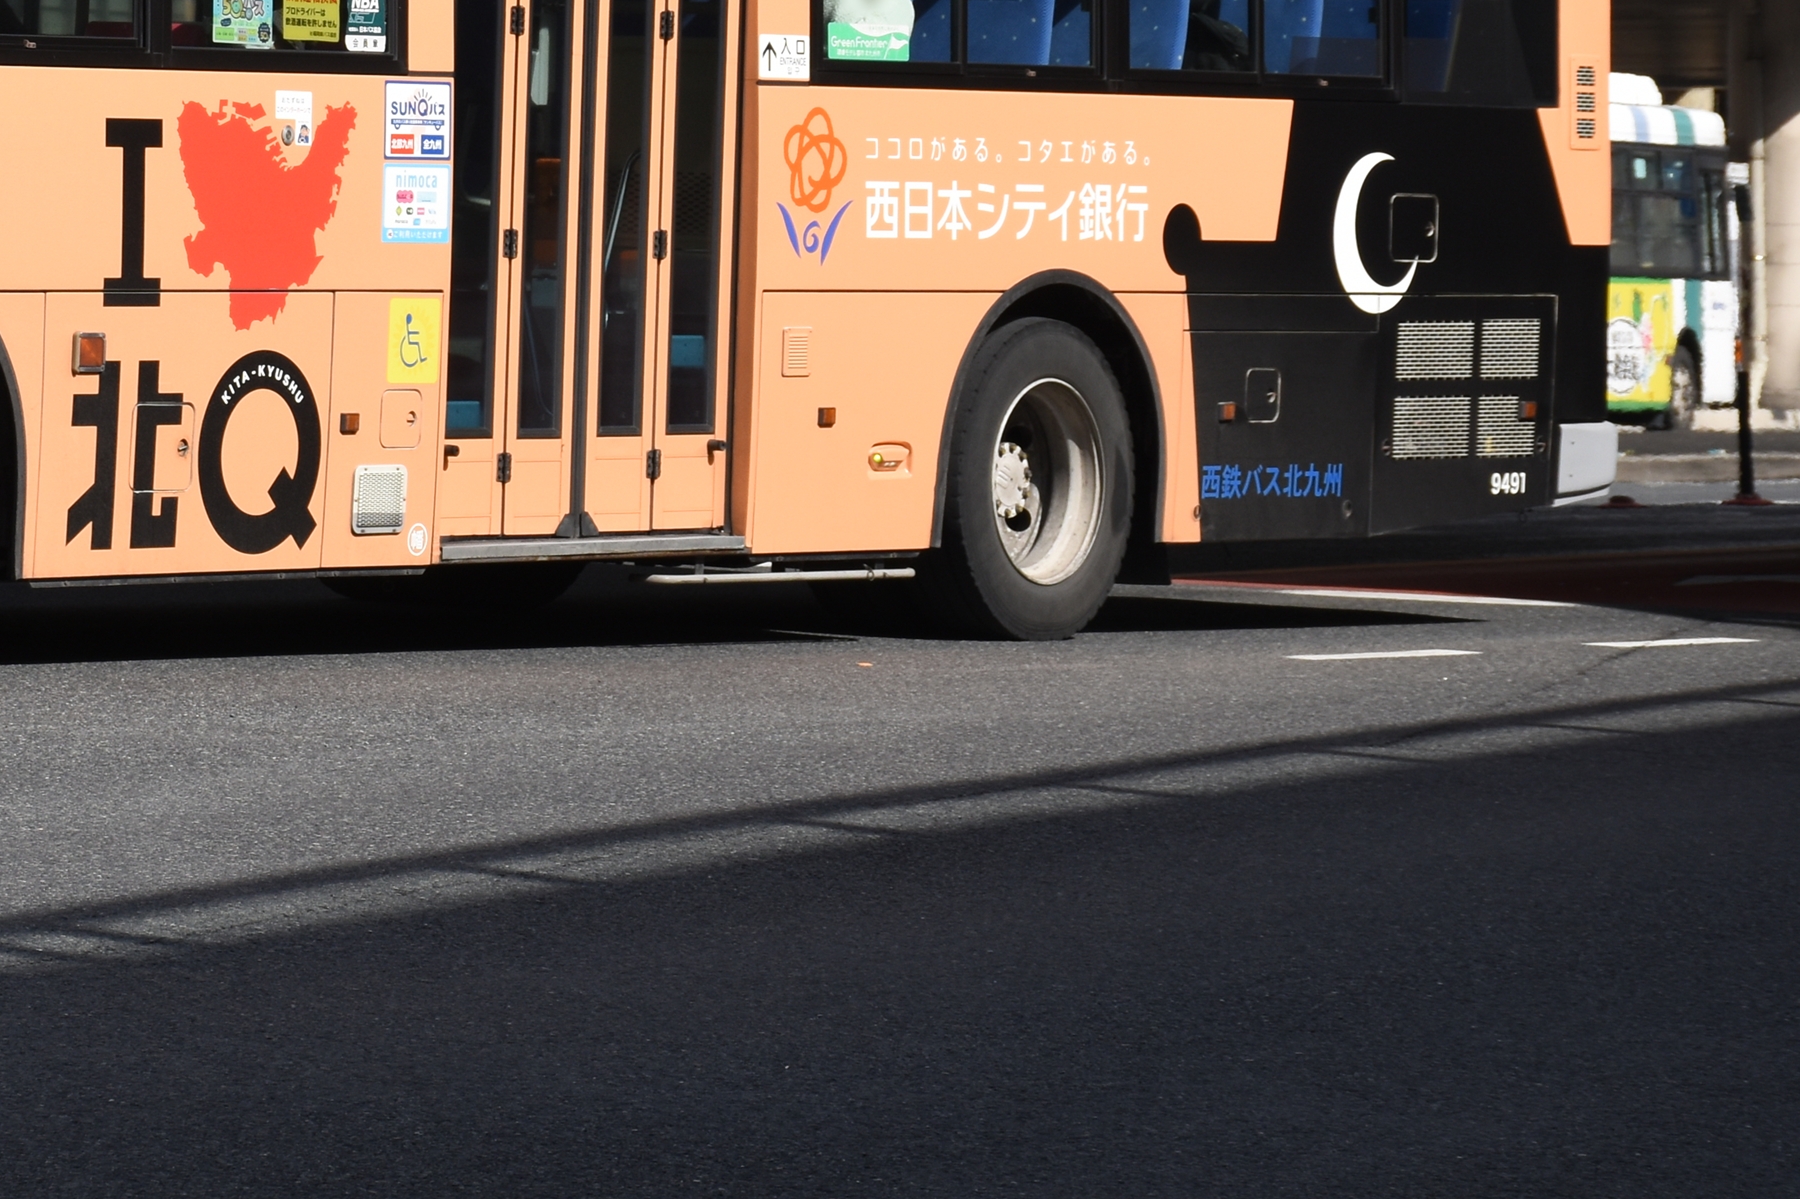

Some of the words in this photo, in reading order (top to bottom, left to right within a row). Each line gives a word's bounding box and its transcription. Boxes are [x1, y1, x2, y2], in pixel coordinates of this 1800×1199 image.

[781, 38, 805, 54] 入口
[395, 170, 438, 188] nimoca
[103, 118, 163, 307] I
[865, 180, 1149, 242] 西日本シティ銀行
[220, 363, 305, 404] KITA-KYUSHU
[1201, 463, 1343, 499] 西鉄バス北九州
[1490, 472, 1526, 495] 9491
